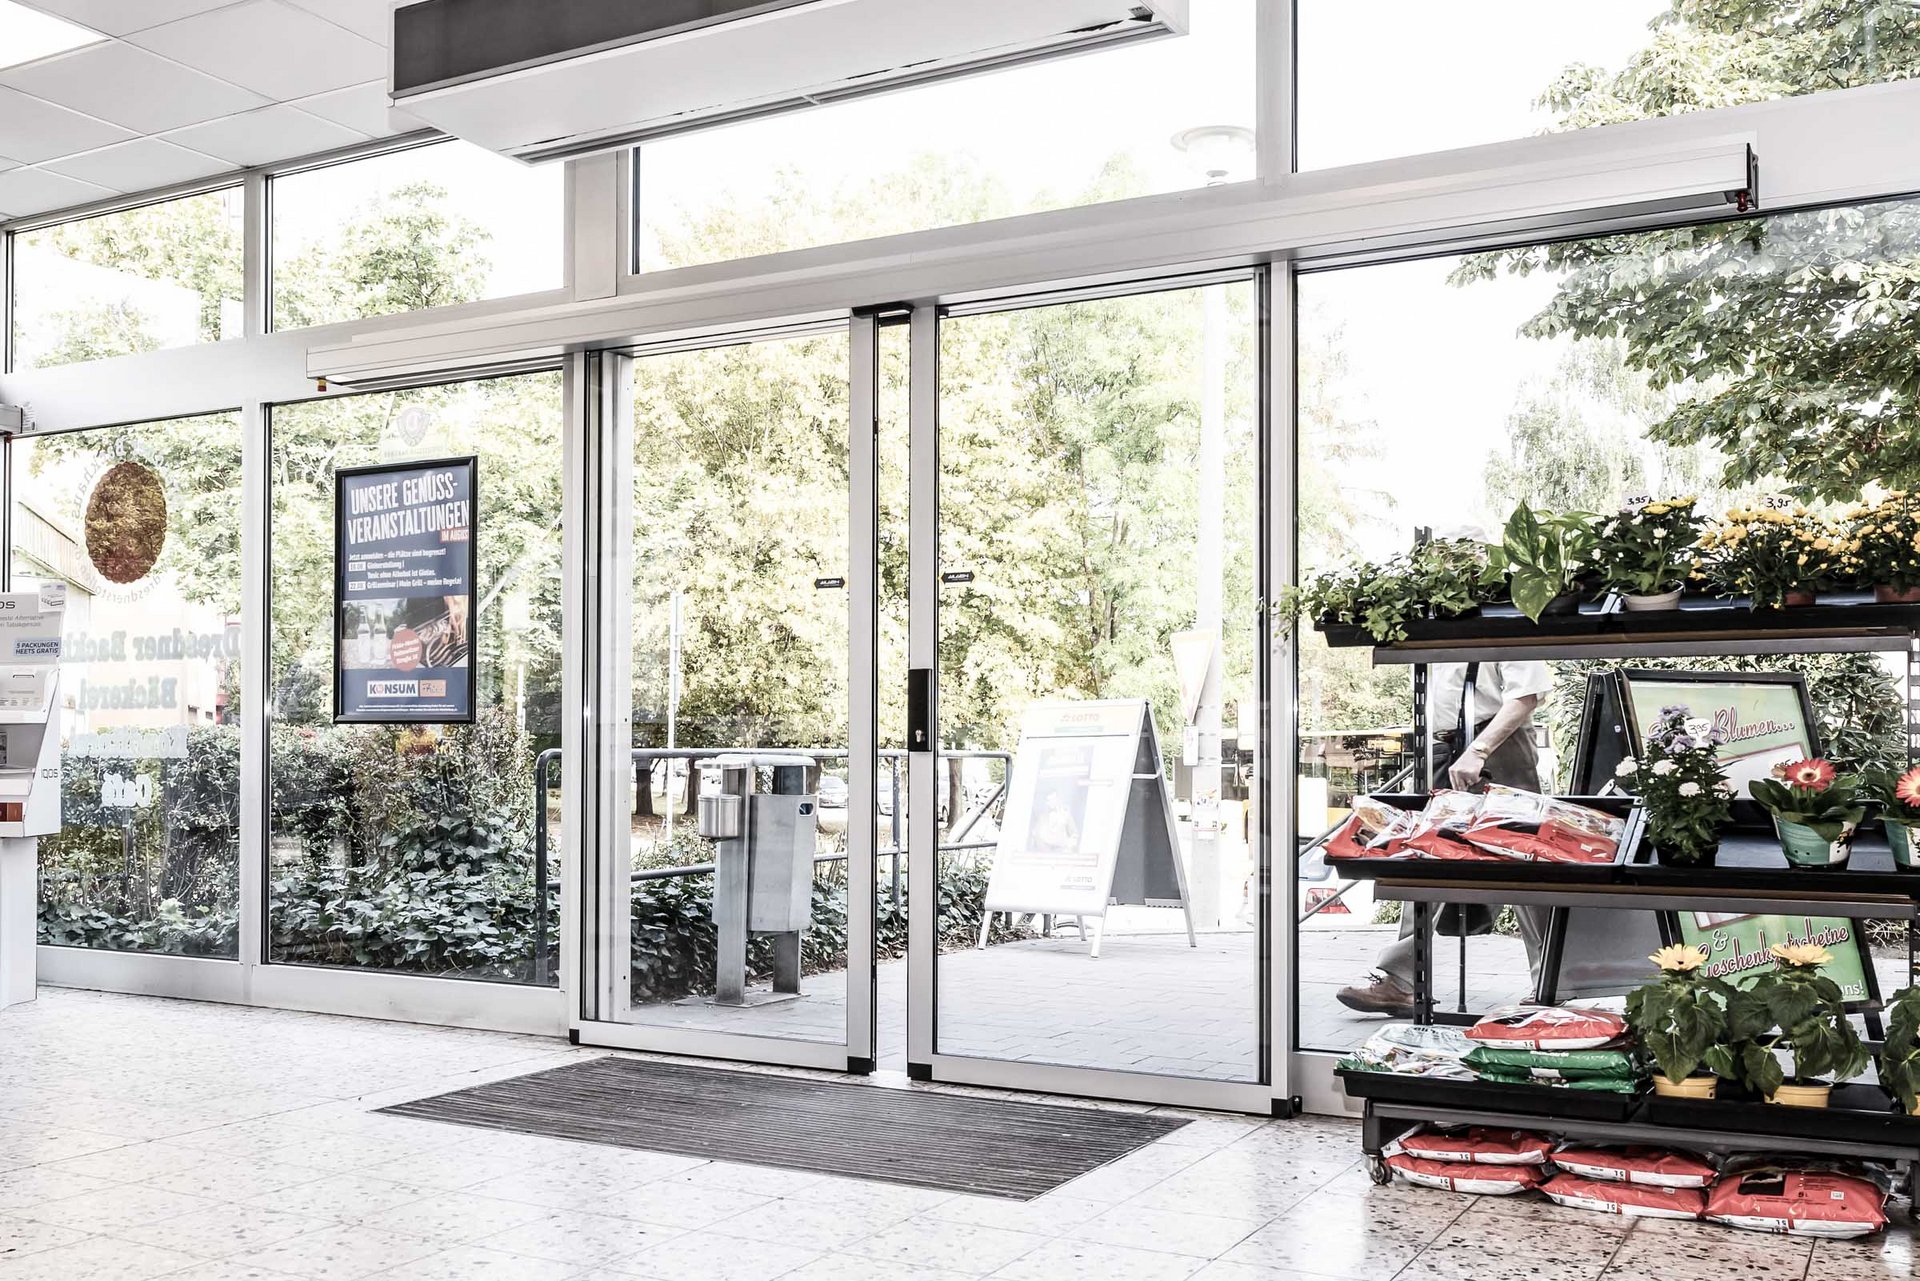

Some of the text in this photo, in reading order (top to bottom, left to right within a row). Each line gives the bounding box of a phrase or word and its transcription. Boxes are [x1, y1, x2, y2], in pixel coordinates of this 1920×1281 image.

[351, 472, 458, 515] UNSERE GENUSS-
[1766, 497, 1791, 510] 3,95
[348, 500, 469, 544] VERANSTALTUNGEN
[369, 683, 416, 695] KONSUM
[41, 768, 59, 779] IQOS
[1712, 928, 1728, 951] &
